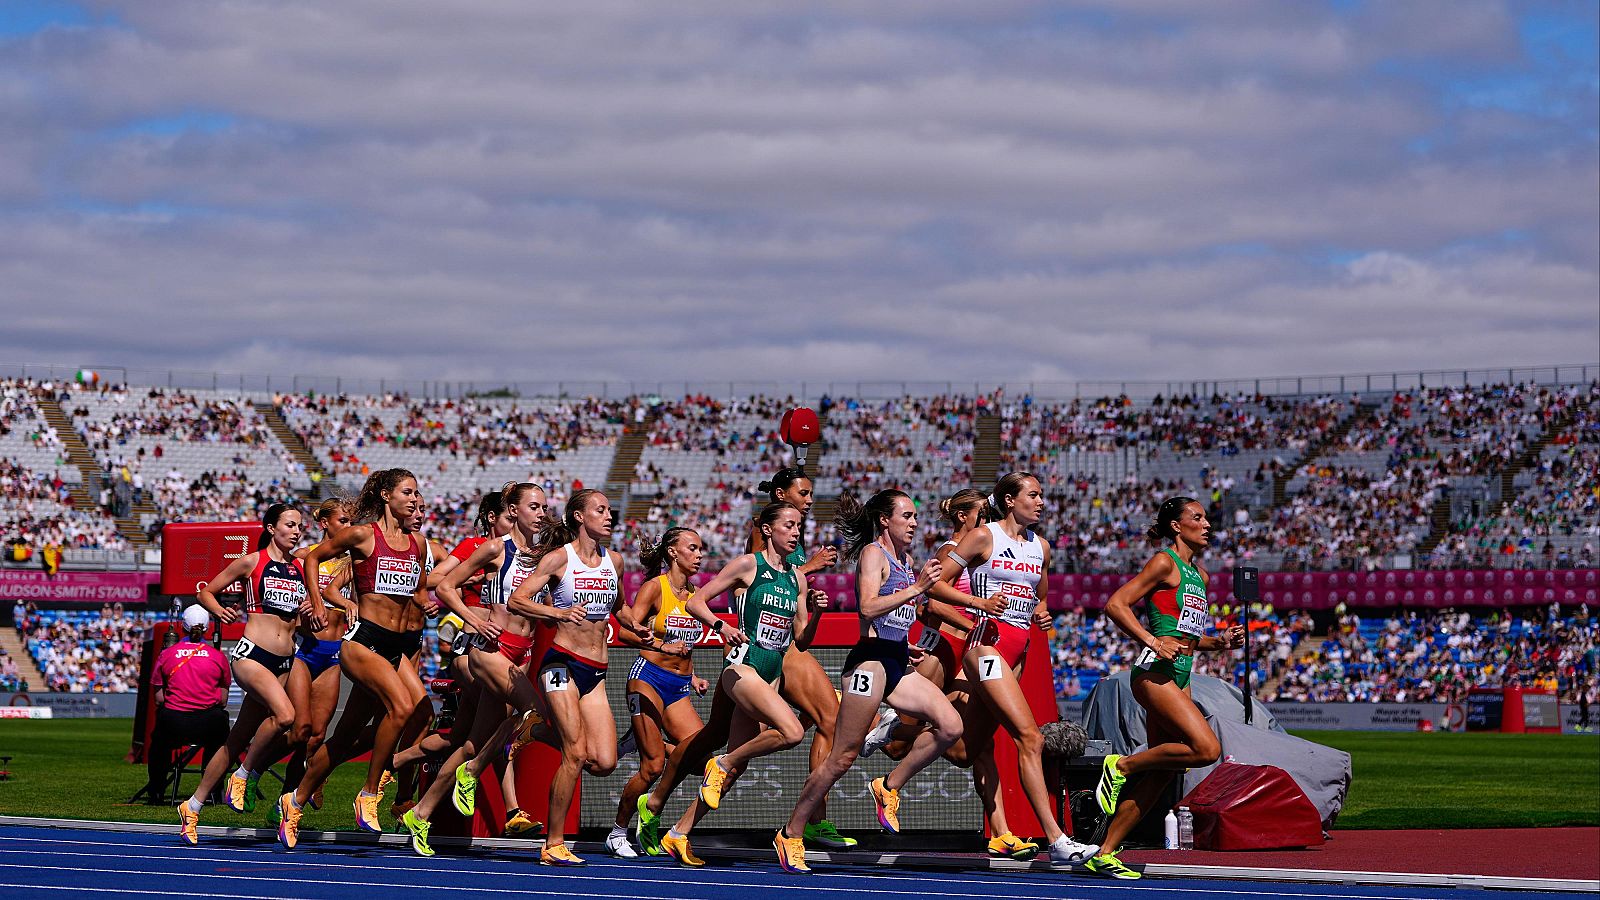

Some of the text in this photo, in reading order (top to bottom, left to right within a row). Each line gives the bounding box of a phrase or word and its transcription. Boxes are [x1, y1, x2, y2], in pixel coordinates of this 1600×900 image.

[379, 560, 412, 572] SPAR
[991, 559, 1042, 575] FRANC
[266, 579, 297, 592] SPAR
[378, 573, 417, 587] NISSEN
[575, 579, 609, 589] SPAR
[98, 587, 143, 599] STAND
[572, 592, 617, 605] SNOWDEN
[1003, 583, 1034, 599] SPAR
[762, 592, 798, 613] IRELAN
[1185, 596, 1205, 611] SPAR
[668, 618, 698, 628] SPAR
[1182, 609, 1206, 628] P SILV
[453, 634, 463, 650] 8
[922, 631, 938, 648] 11
[235, 640, 250, 656] 12
[983, 659, 995, 677] 7
[550, 672, 562, 687] 4
[853, 673, 870, 693] 13
[629, 697, 637, 713] 6
